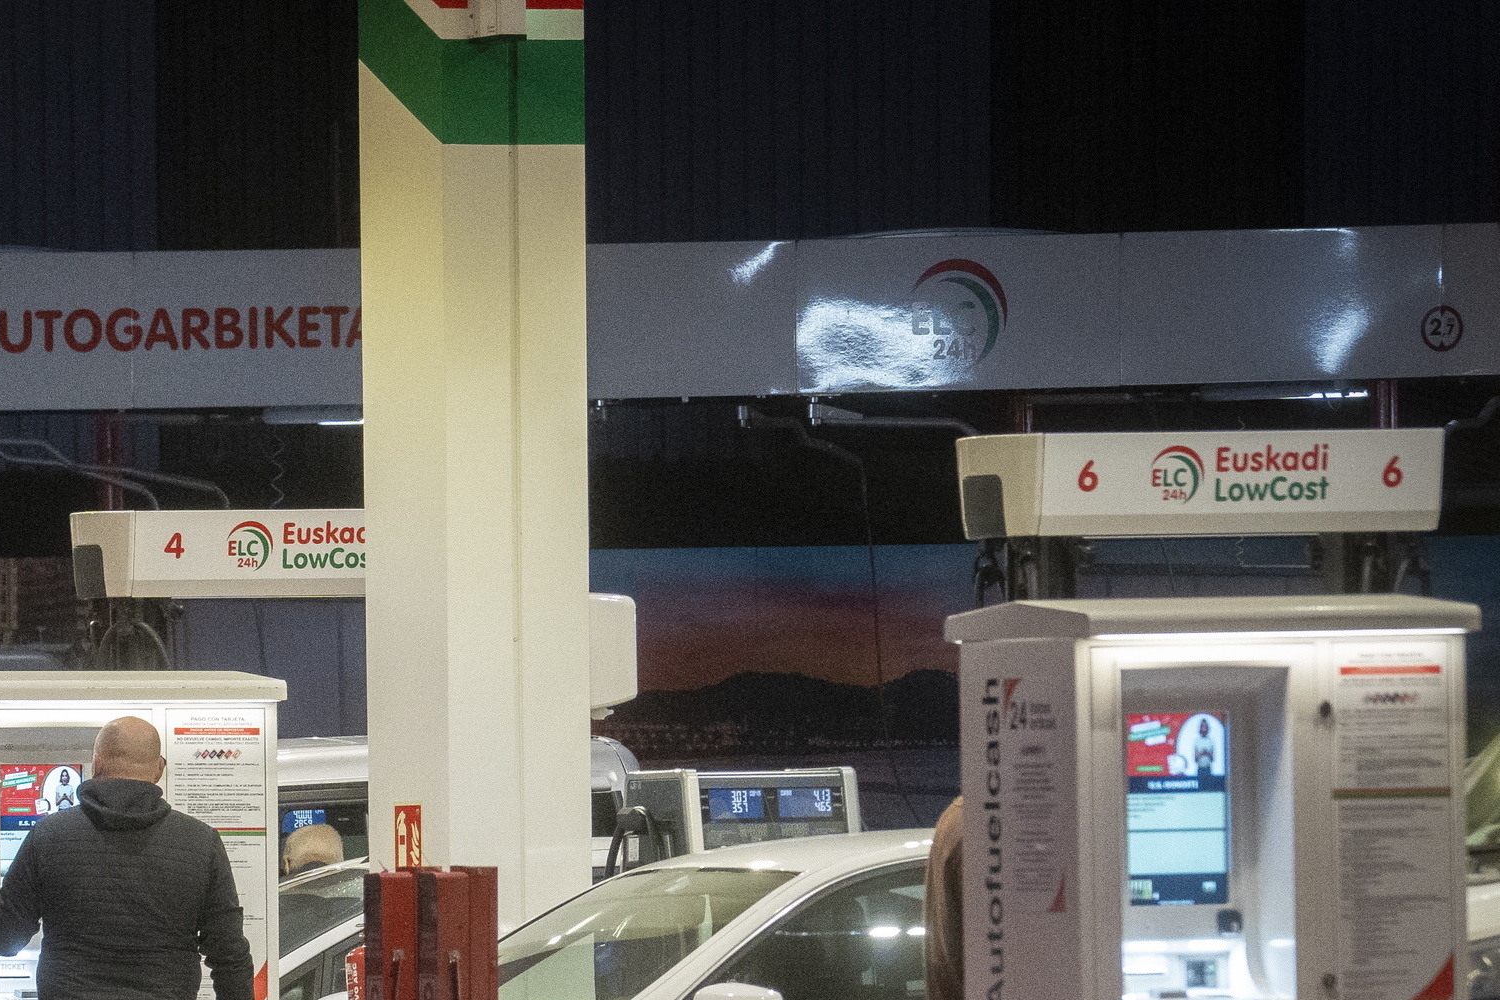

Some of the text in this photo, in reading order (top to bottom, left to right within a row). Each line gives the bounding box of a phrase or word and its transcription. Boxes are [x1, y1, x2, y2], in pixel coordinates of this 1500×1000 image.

[911, 301, 977, 336] ELC
[1215, 443, 1330, 473] Euskadi
[1381, 455, 1404, 488] 6
[1077, 459, 1099, 493] 6
[1151, 467, 1188, 488] ELC
[1215, 475, 1330, 502] LowCost
[1161, 488, 1187, 502] 24h
[163, 532, 185, 559] 4
[227, 540, 259, 557] ELC
[237, 557, 259, 568] 24h
